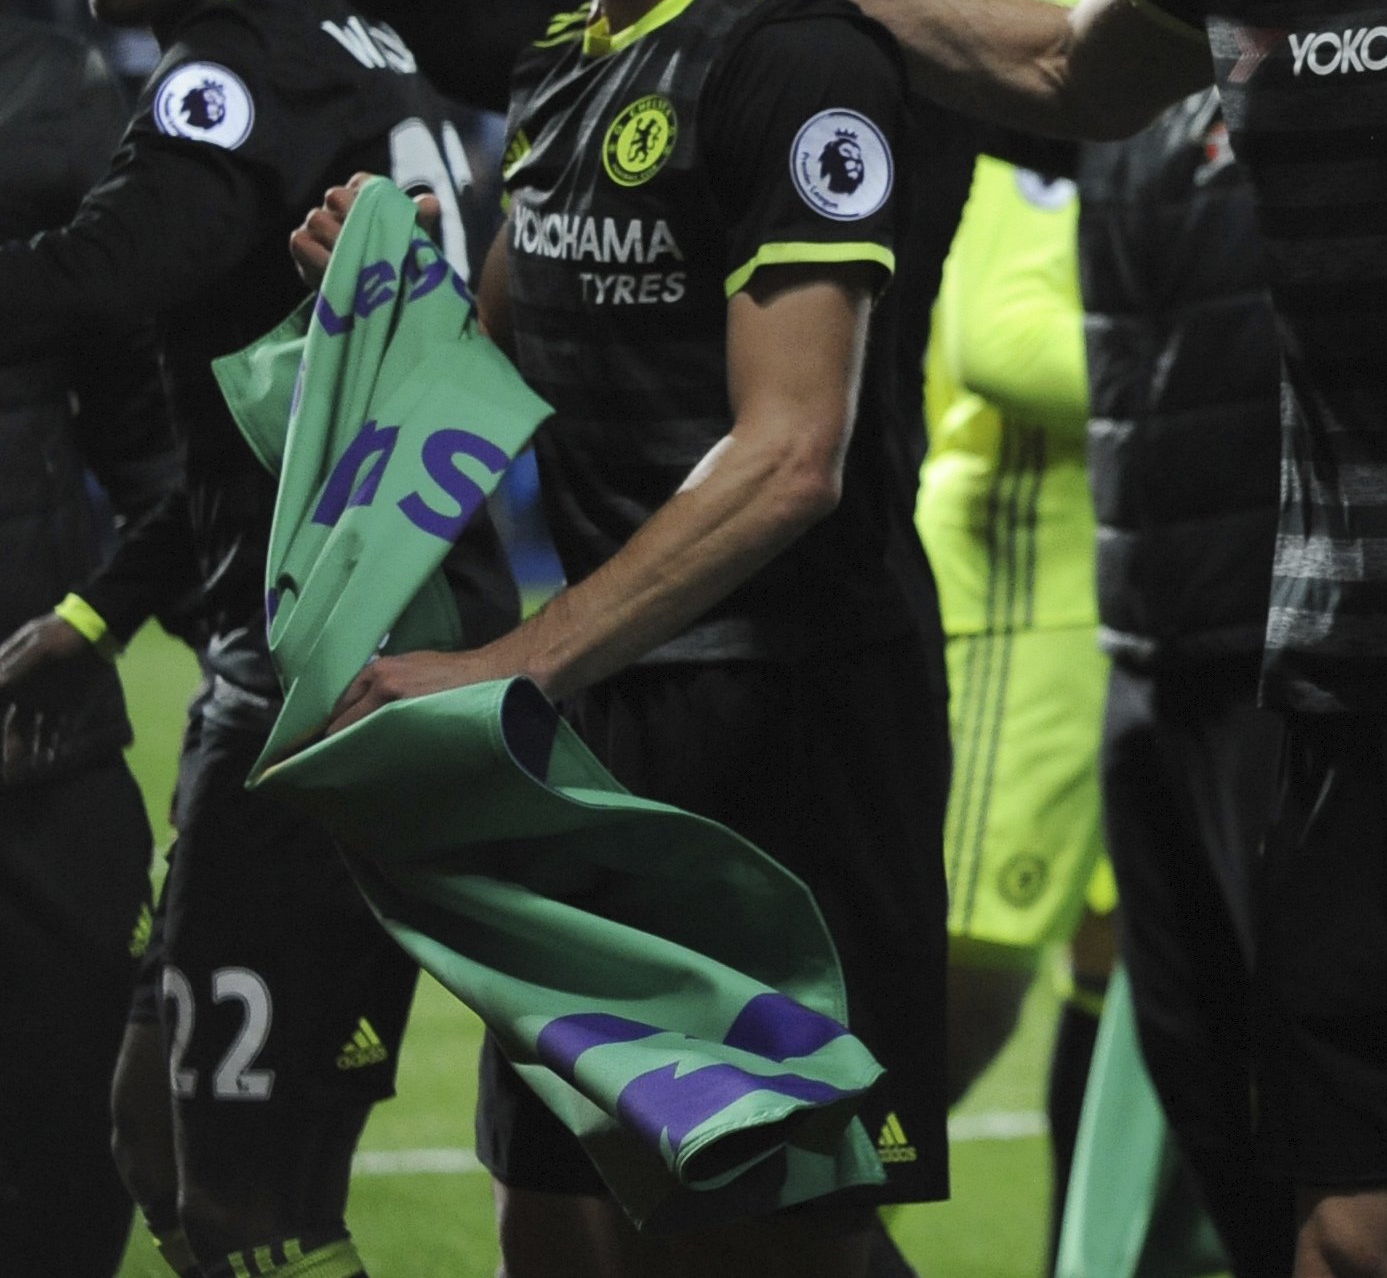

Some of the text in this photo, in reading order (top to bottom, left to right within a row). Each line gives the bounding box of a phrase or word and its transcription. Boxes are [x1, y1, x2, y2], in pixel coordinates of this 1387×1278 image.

[513, 205, 685, 264] YOKOHAMA
[579, 272, 687, 306] TYRES
[162, 965, 276, 1101] 22
